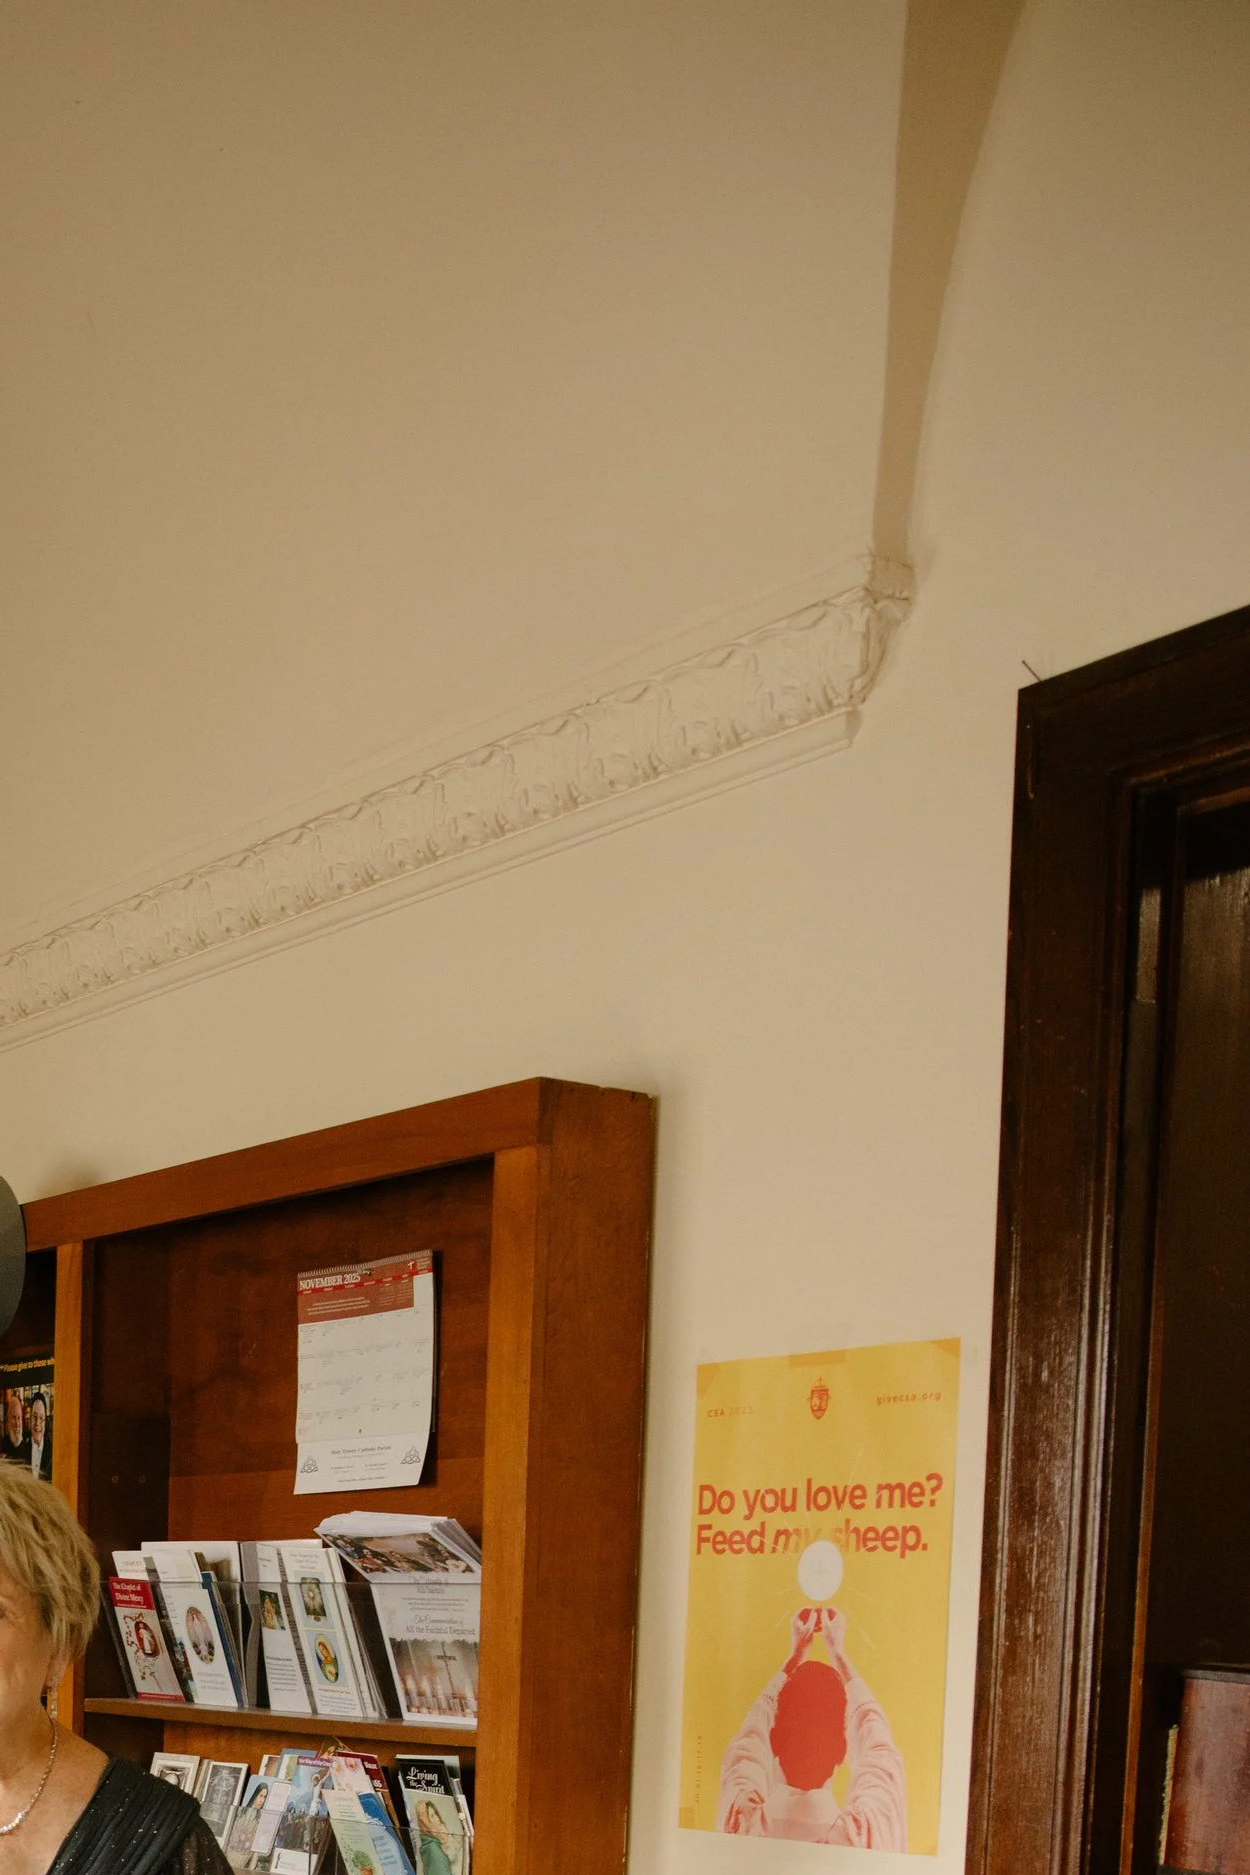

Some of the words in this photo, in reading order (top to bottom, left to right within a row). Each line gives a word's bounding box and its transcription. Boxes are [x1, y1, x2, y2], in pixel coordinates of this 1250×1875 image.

[300, 1274, 343, 1290] NOVEMBER
[343, 1272, 361, 1285] 2025
[876, 1391, 942, 1406] givecsa.org
[707, 1409, 725, 1418] CSA
[729, 1406, 754, 1416] 2025
[698, 1484, 736, 1516] Do
[742, 1487, 798, 1521] you
[805, 1478, 868, 1512] love
[875, 1472, 944, 1509] me?
[696, 1521, 766, 1555] Feed
[832, 1518, 928, 1559] sheep.
[406, 1766, 438, 1786] Living
[416, 1780, 445, 1794] Spirit
